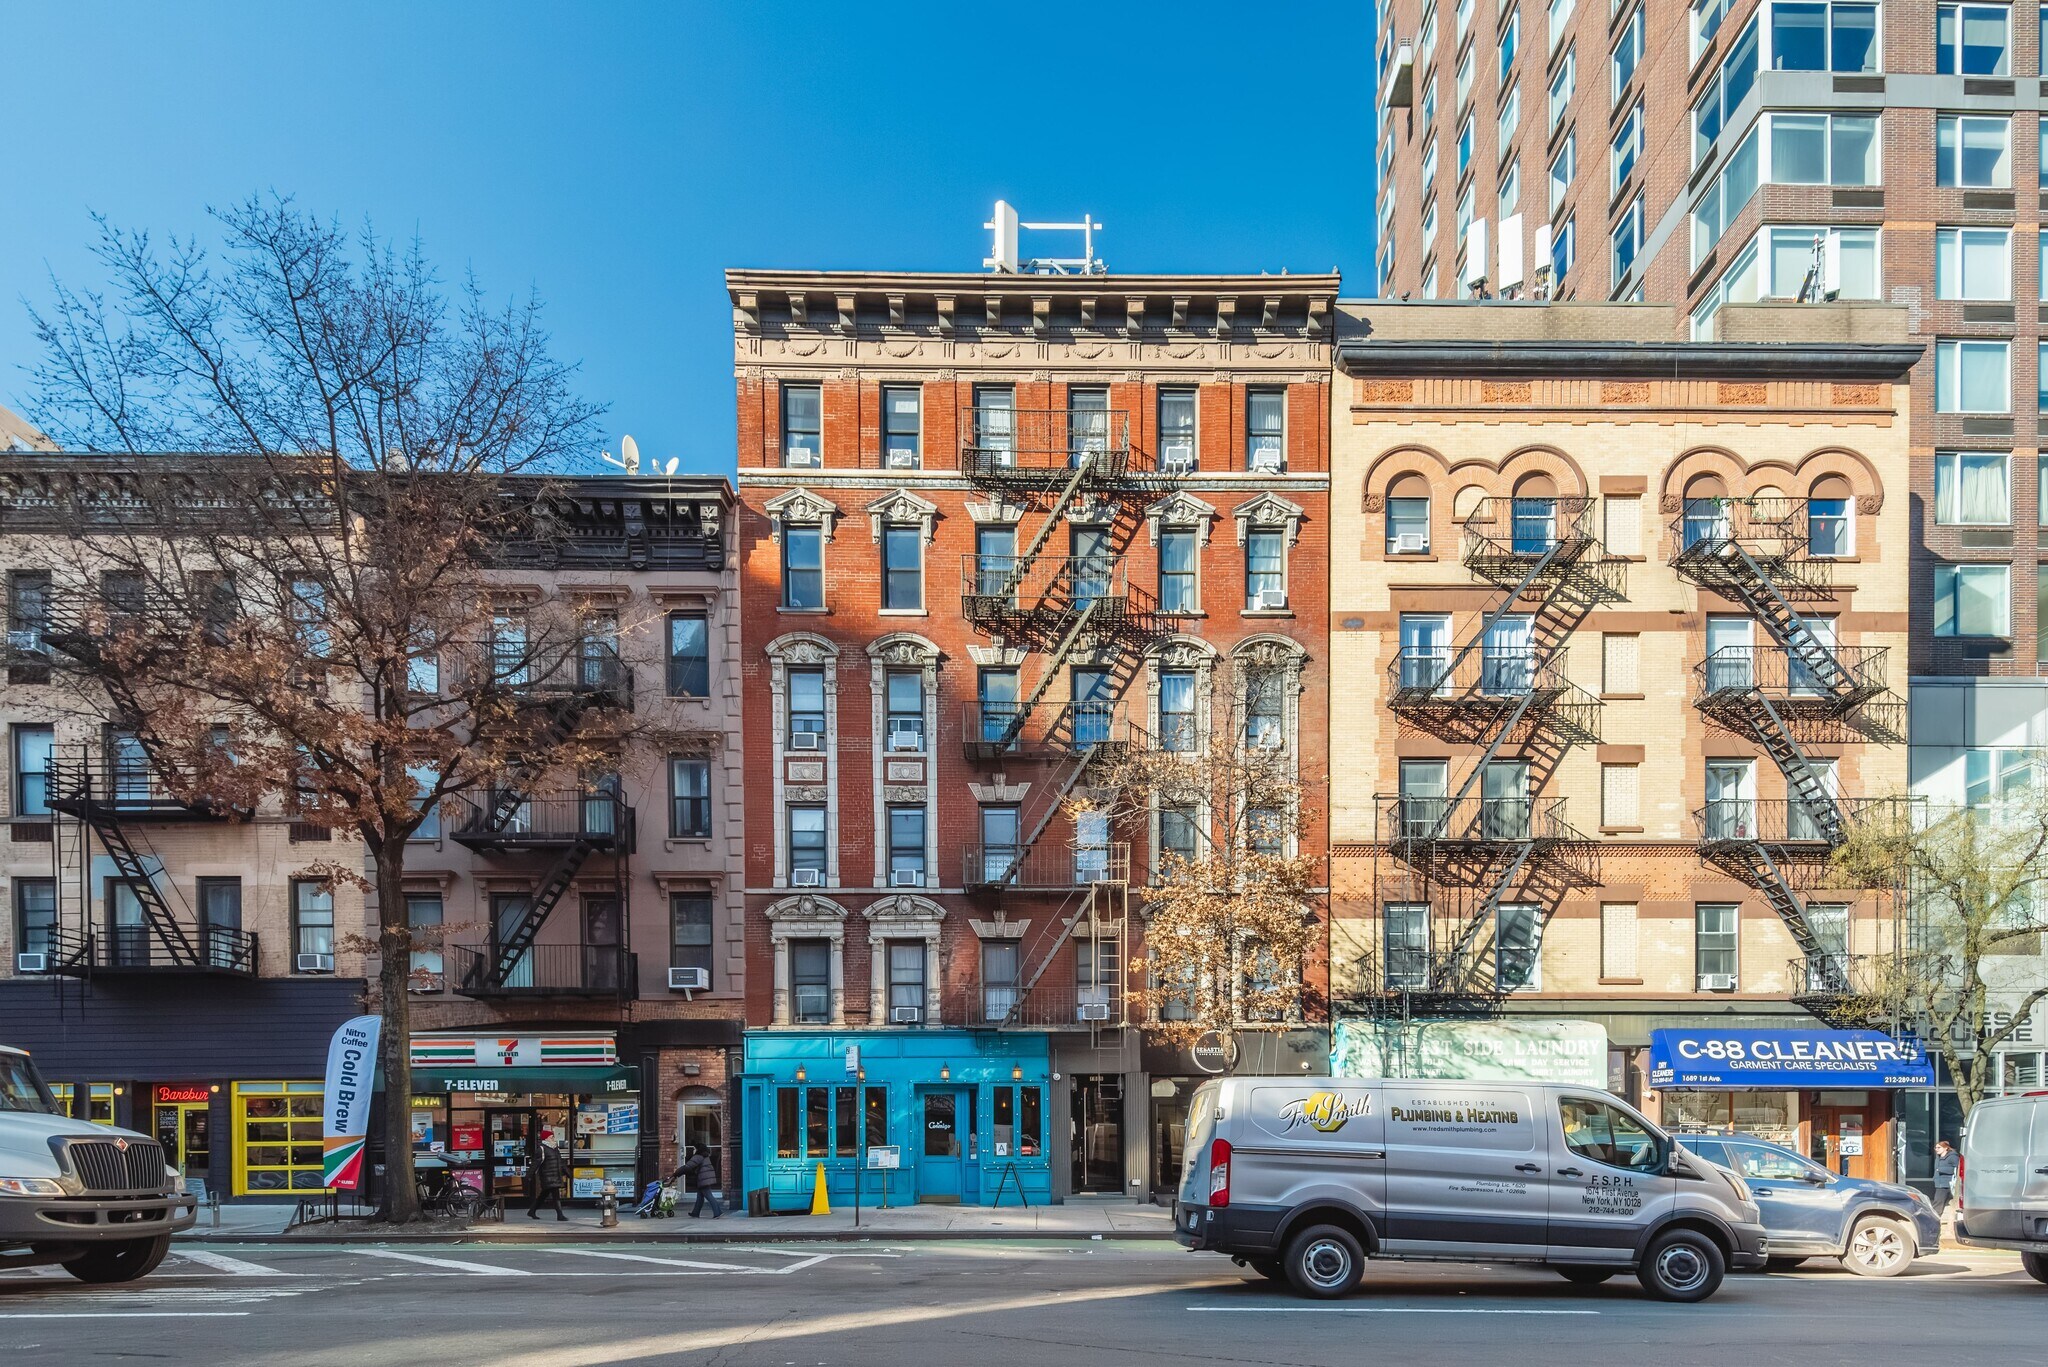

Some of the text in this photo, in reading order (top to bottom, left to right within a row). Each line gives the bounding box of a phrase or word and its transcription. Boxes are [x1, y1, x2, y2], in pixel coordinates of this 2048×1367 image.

[345, 1028, 367, 1038] Nitro
[341, 1036, 368, 1048] Coffee
[1463, 1040, 1504, 1056] SIDE
[1514, 1040, 1600, 1056] LAUNDRY
[498, 1040, 518, 1064] 7
[1678, 1040, 1918, 1060] C-88 CLEANERS
[1658, 1061, 1667, 1069] DRY
[1729, 1061, 1878, 1071] GARMENT CARE SPECIALISTS
[1531, 1068, 1595, 1076] SHIRT LAUNDRY
[1652, 1069, 1674, 1077] CLEANERS
[335, 1049, 361, 1134] Cold Brew
[414, 1097, 440, 1106] ATM
[1279, 1092, 1371, 1135] Fred Smith
[1455, 1110, 1464, 1123] &
[1591, 1175, 1633, 1187] F. S. P. H.
[1585, 1186, 1639, 1198] 1674 First Avenue
[1582, 1195, 1595, 1205] New
[1624, 1198, 1641, 1208] 10128
[1588, 1206, 1634, 1215] 212-744-1300
